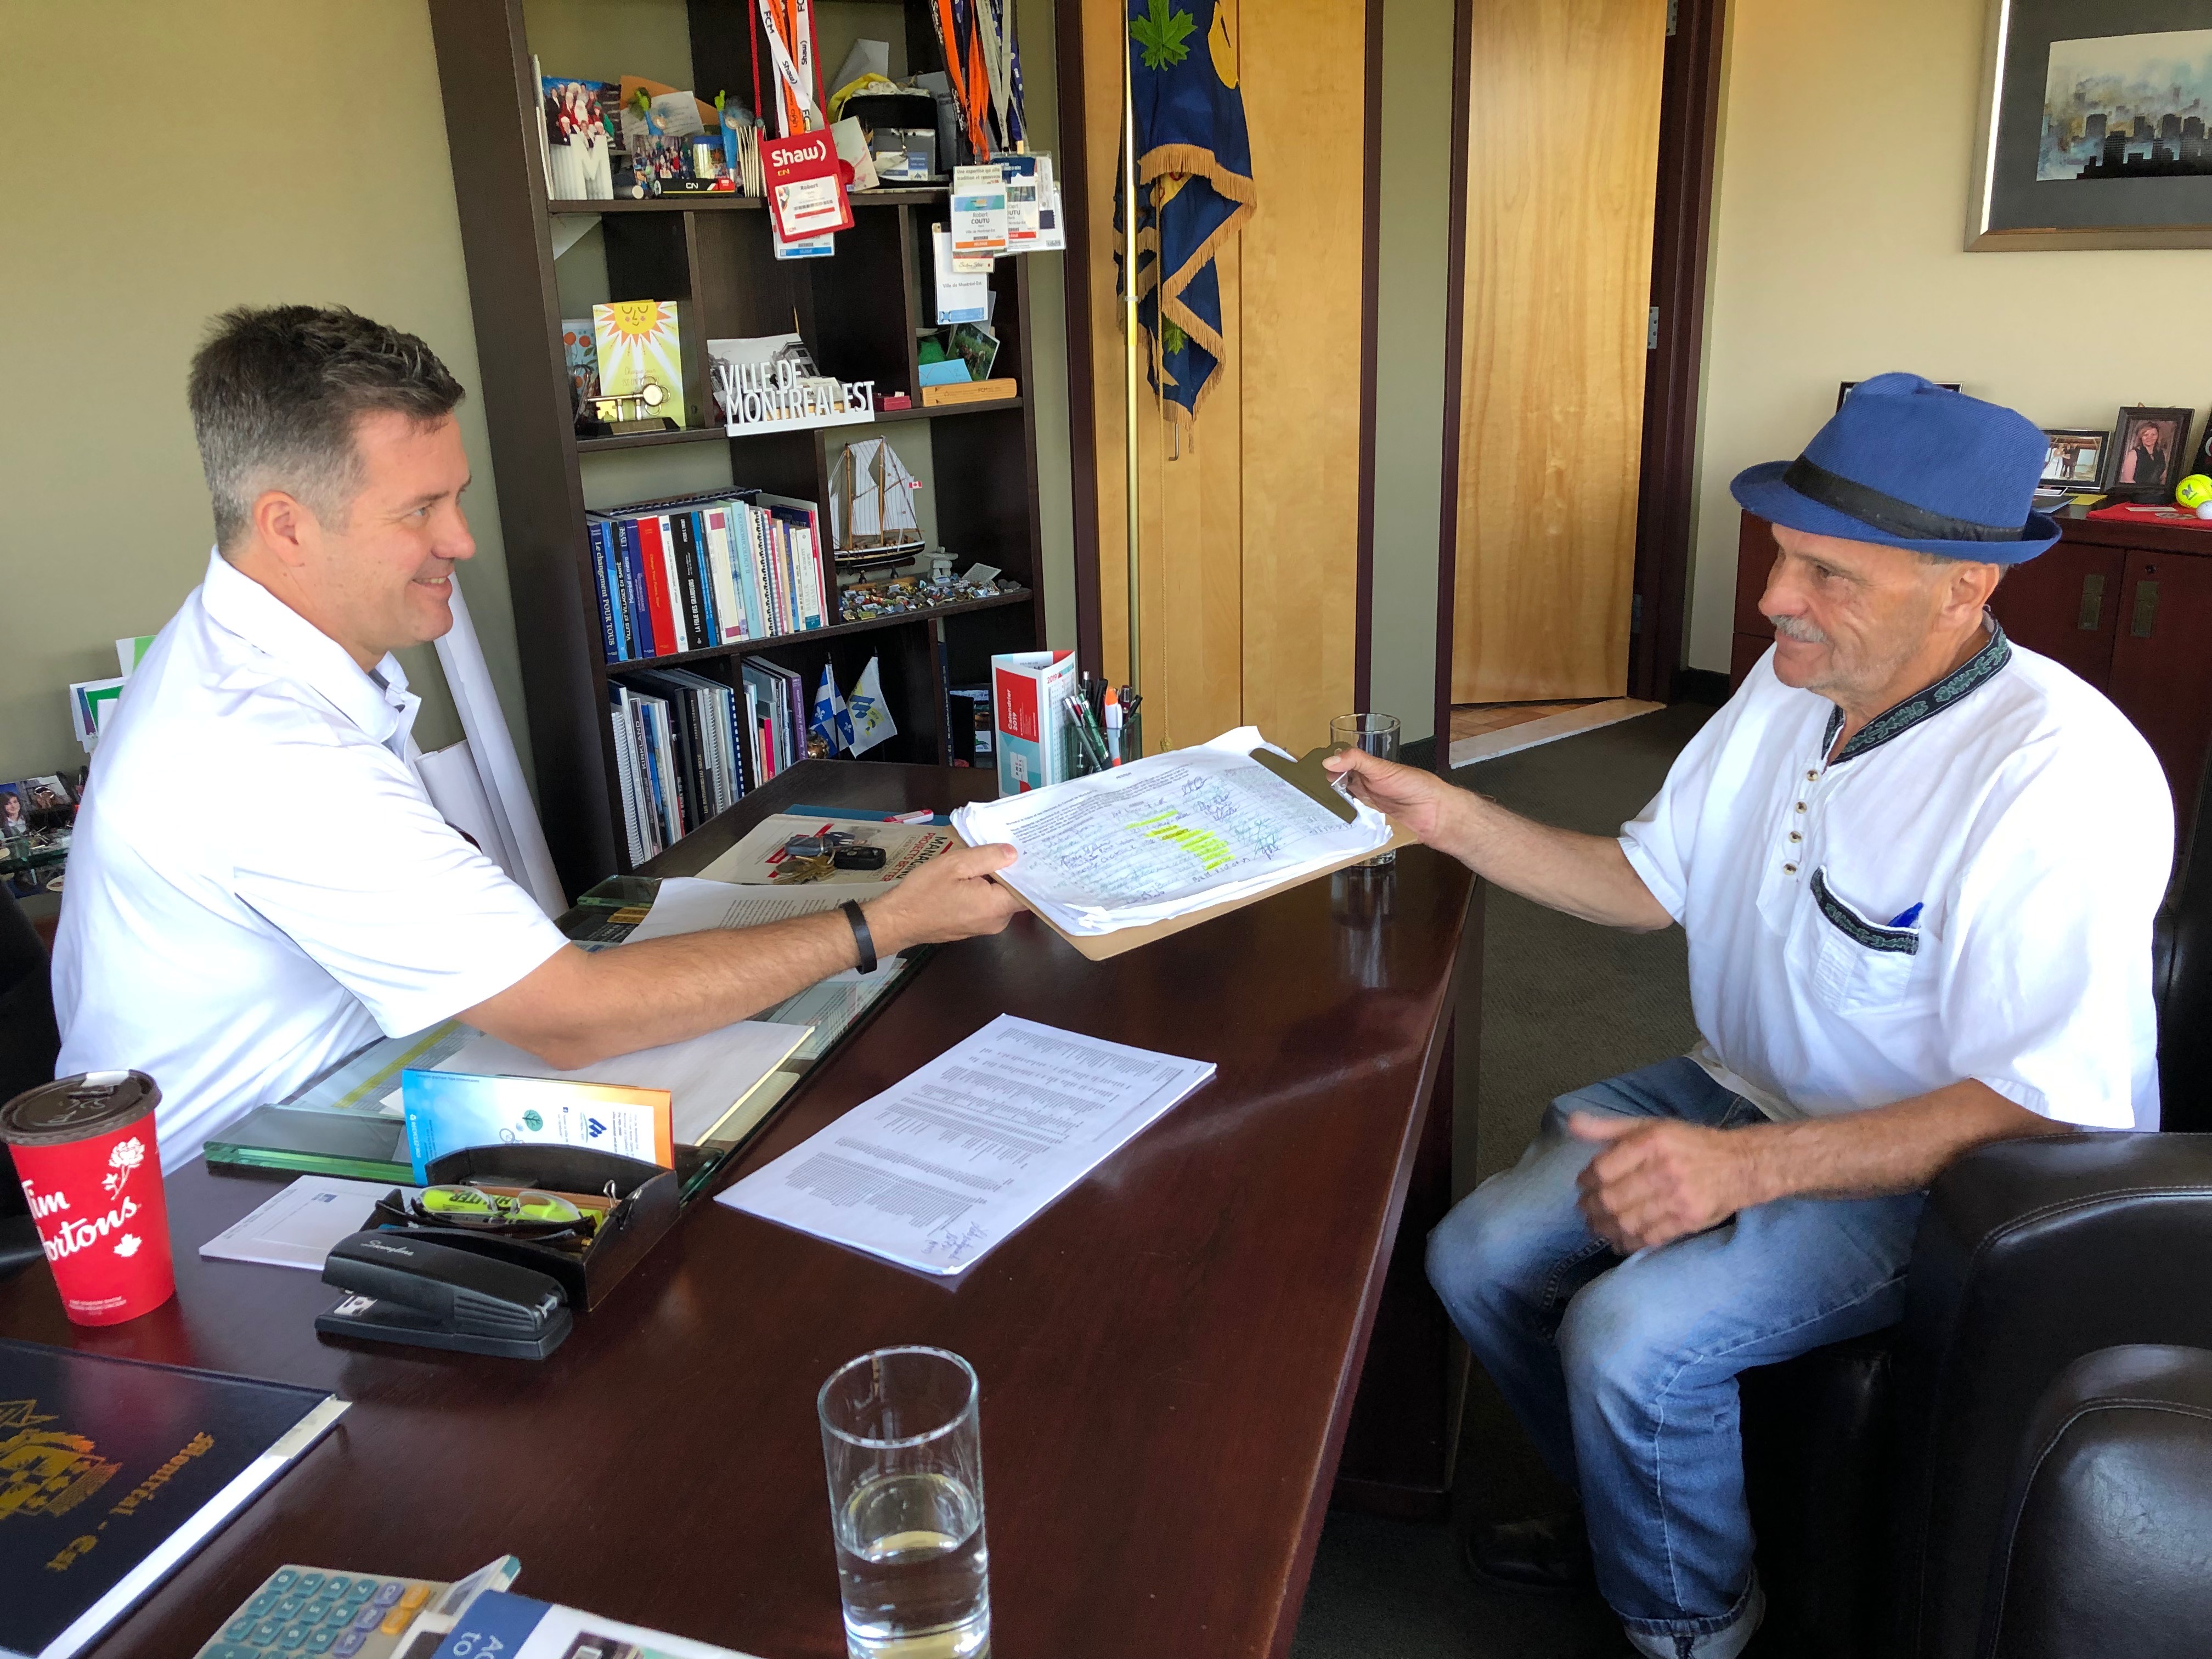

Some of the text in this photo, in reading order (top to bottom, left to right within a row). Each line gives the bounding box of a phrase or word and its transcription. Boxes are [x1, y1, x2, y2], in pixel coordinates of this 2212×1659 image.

[763, 10, 775, 33] FCM
[719, 358, 802, 396] VILLE DE
[726, 380, 875, 425] MONTREAL EST
[737, 514, 749, 567] ECONOMICOLOGY
[595, 541, 616, 646] Le changement POUR TOUS
[804, 583, 812, 612] BARACK
[1047, 673, 1058, 684] 2019
[635, 720, 647, 769] KIRKLAND
[879, 832, 936, 882] PROJECTS BETTER
[40, 1195, 139, 1262] ortons
[453, 1632, 482, 1656] to
